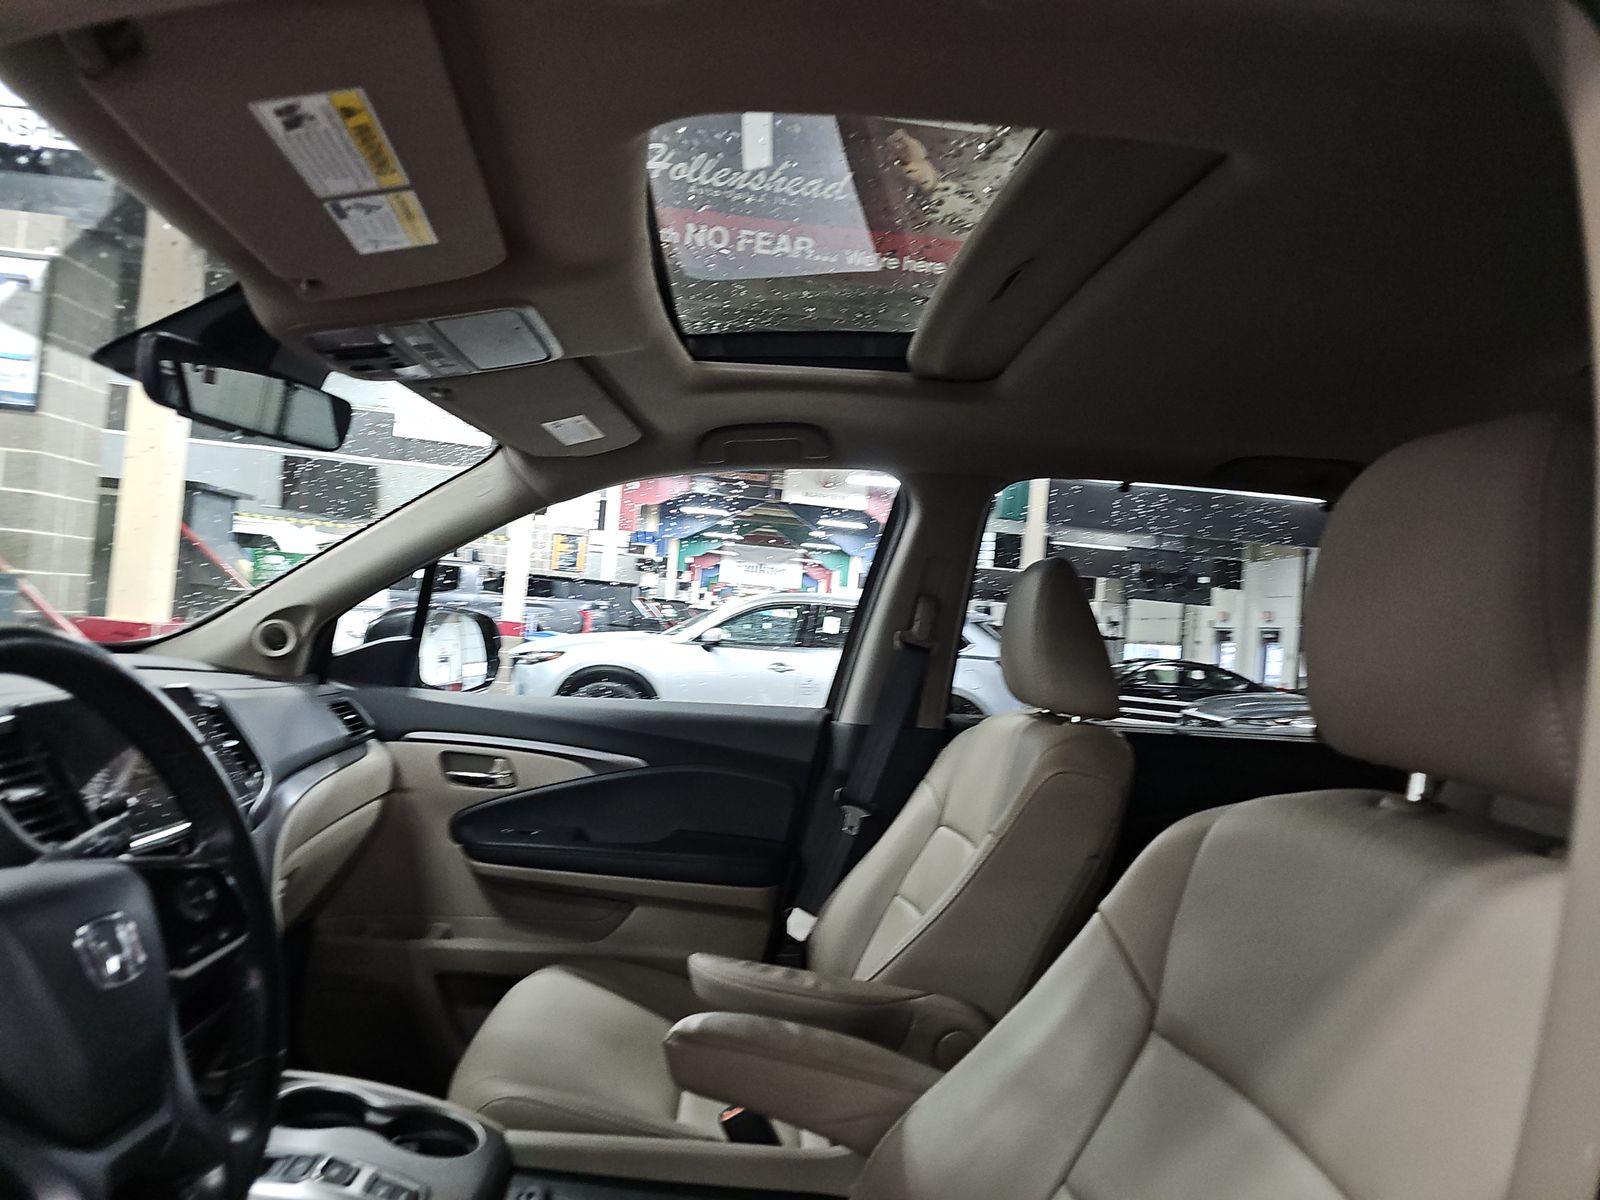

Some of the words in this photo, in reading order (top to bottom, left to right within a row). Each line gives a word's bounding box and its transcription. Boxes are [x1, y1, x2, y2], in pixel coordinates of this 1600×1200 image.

[645, 142, 854, 201] Hollenshead
[684, 223, 731, 250] NO
[902, 255, 947, 275] here
